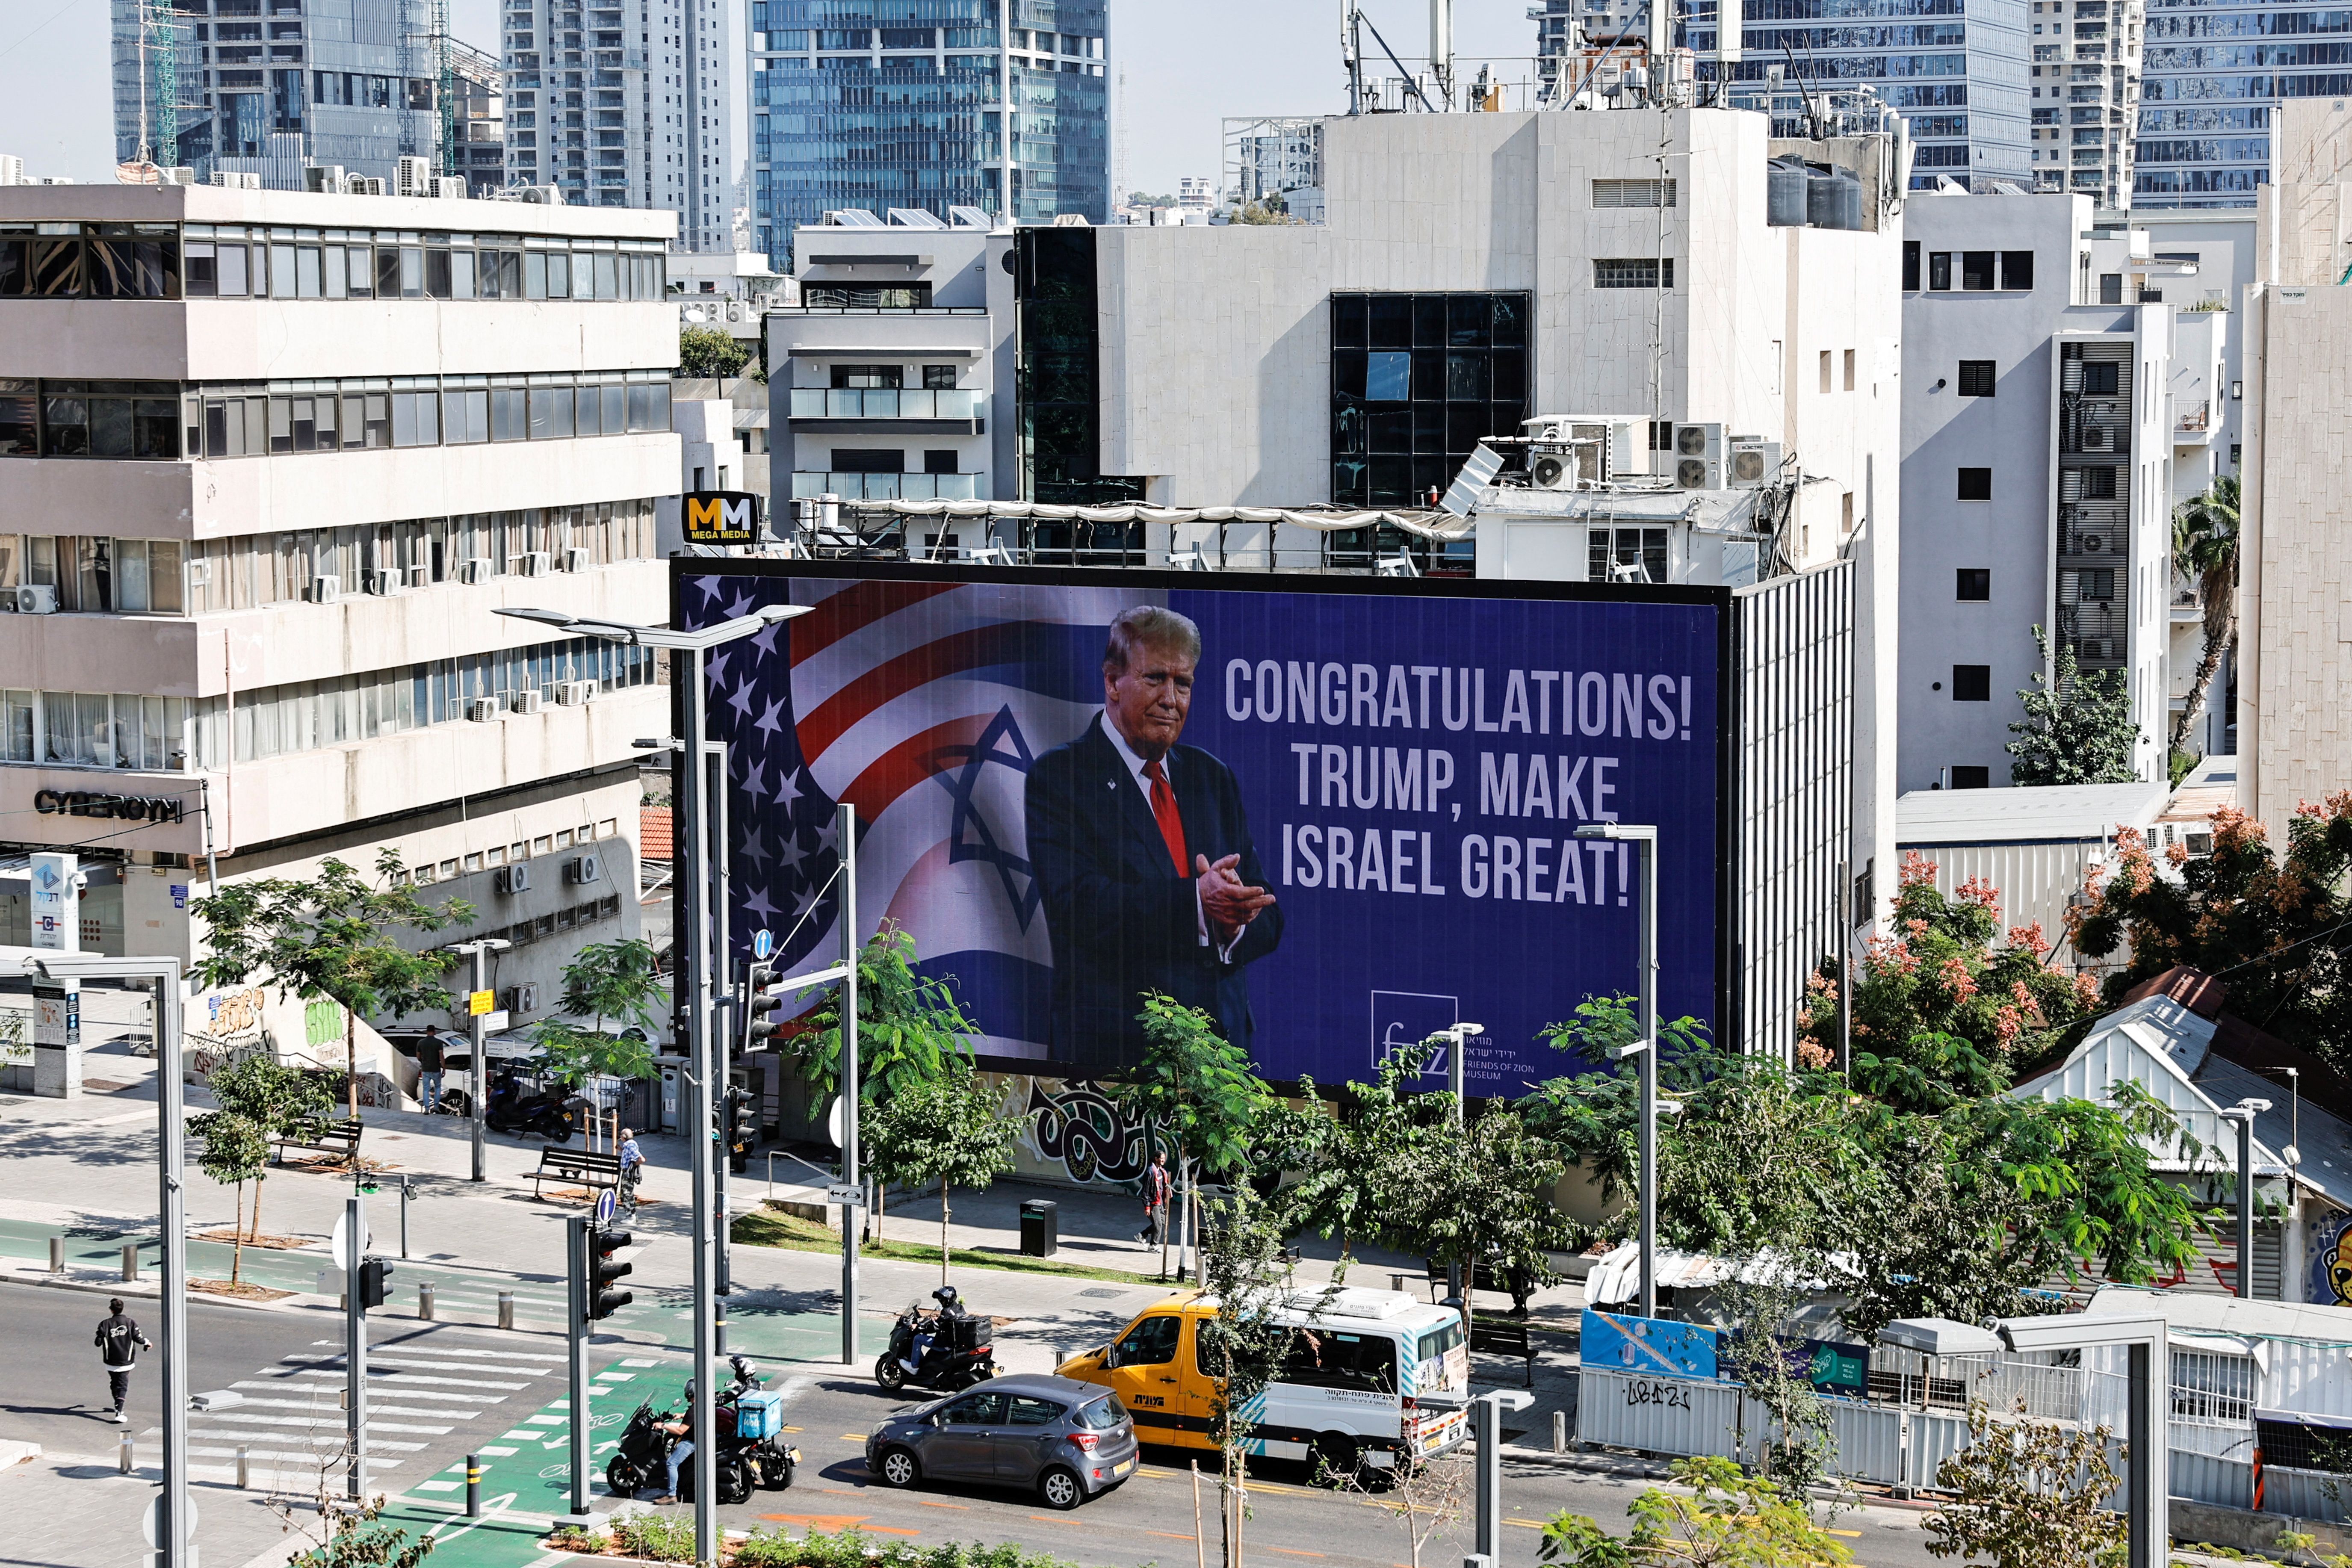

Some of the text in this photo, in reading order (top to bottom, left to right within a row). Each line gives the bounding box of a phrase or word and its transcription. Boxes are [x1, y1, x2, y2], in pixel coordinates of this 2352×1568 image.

[688, 498, 751, 530] MM
[691, 530, 750, 539] MEGA MEDIA
[1226, 659, 1691, 741] CONGRATULATIONS!
[1291, 743, 1619, 822] TRUMP, MAKE
[34, 790, 182, 824] CYBERGYM
[1283, 824, 1628, 907] ISRAEL GREAT!
[44, 918, 52, 929] C
[1463, 1046, 1516, 1059] ידידי ישראל
[1463, 1060, 1534, 1073] FRIENDS OF ZION
[1463, 1070, 1501, 1080] MUSEUM
[1325, 1389, 1370, 1398] פתח-תקווה
